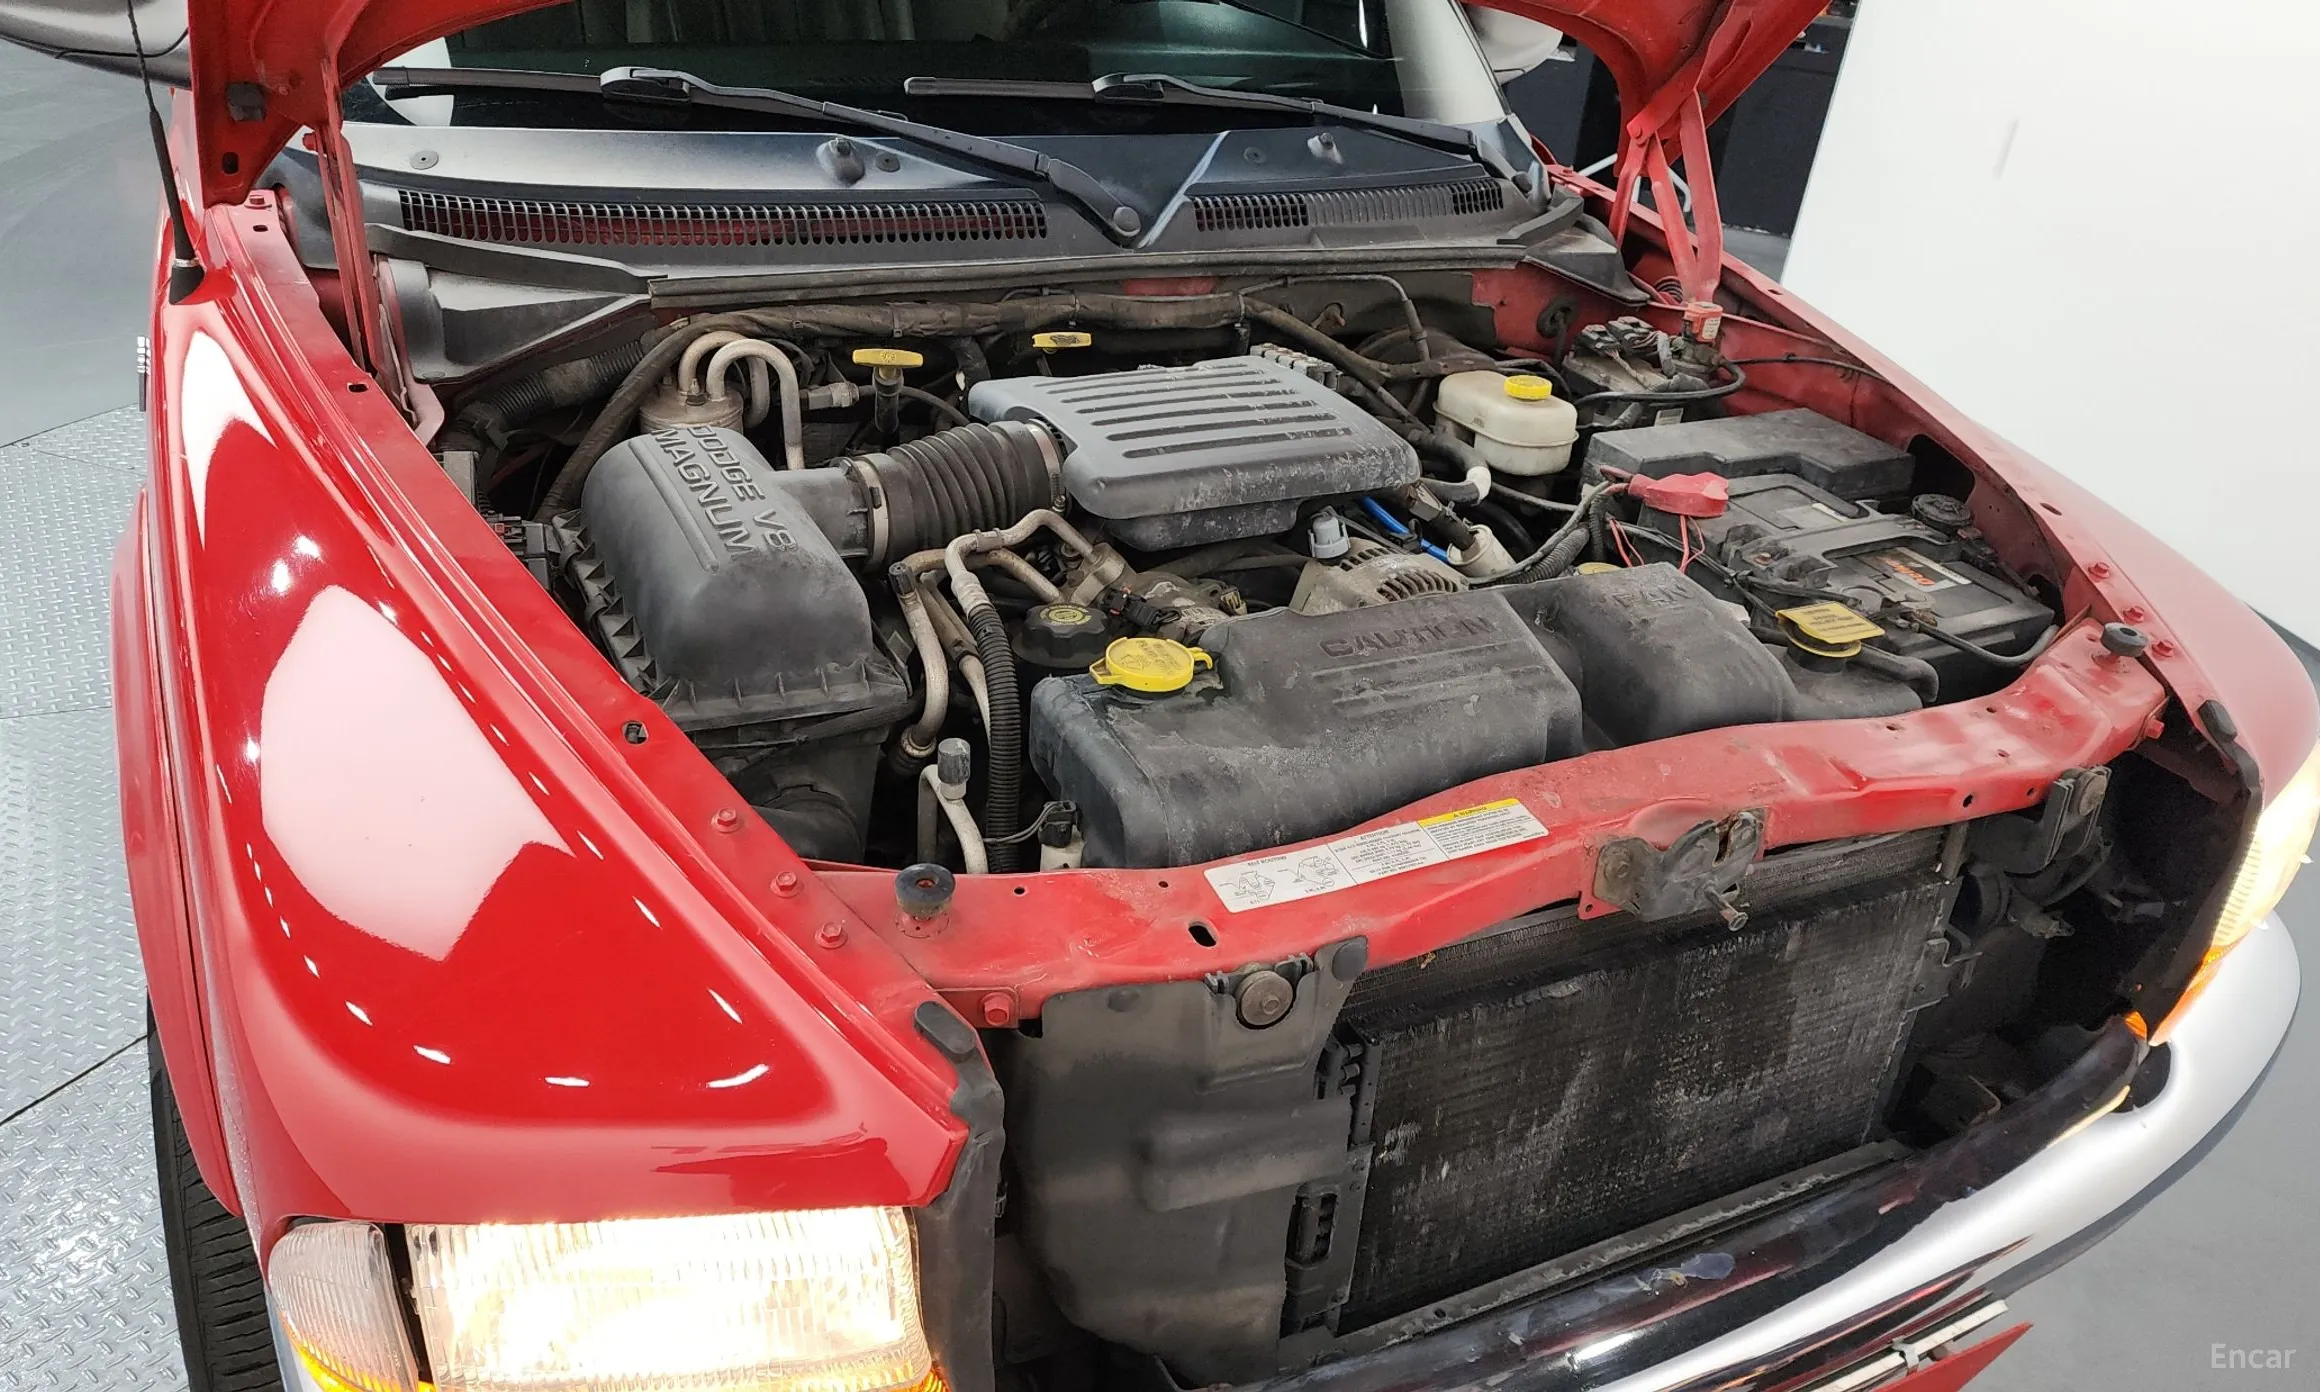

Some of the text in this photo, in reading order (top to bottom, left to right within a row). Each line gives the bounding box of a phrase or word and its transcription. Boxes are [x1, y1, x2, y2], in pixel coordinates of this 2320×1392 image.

[650, 428, 757, 560] MAGNUM
[687, 424, 798, 552] DODGE V8
[1319, 615, 1498, 658] CAUTION
